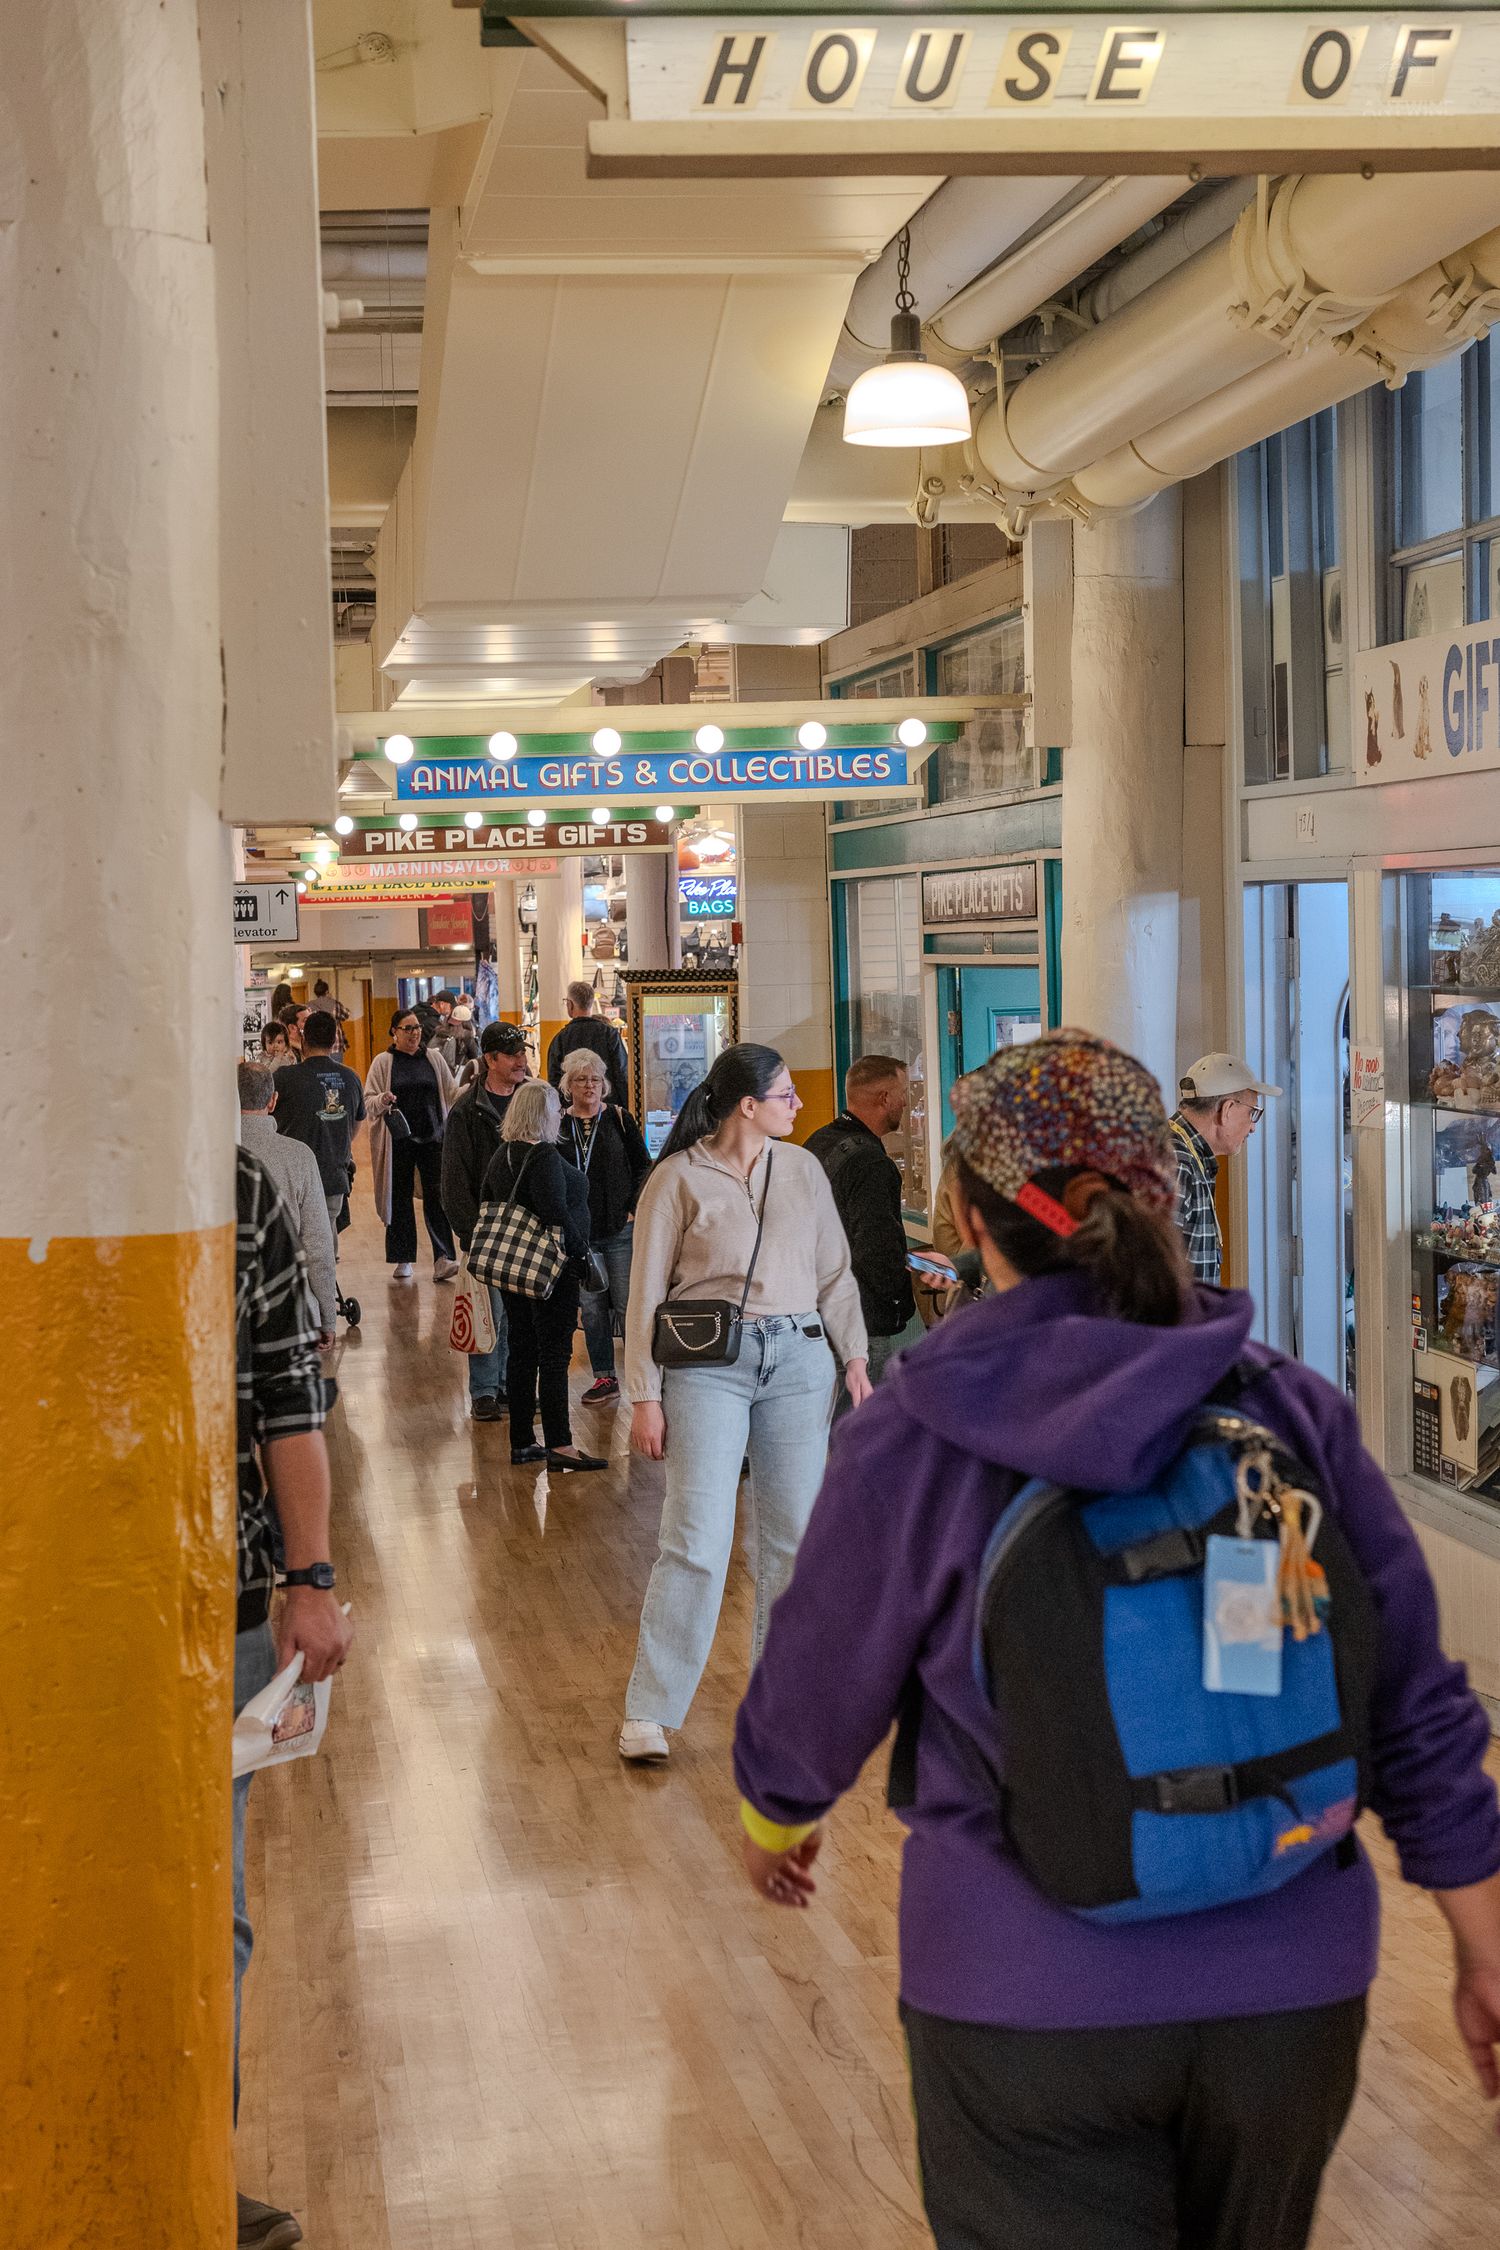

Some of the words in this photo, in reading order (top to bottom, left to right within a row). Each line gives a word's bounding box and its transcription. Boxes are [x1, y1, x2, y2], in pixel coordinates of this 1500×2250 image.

[702, 31, 1159, 105] HOUSE
[1302, 29, 1453, 101] OF
[410, 763, 529, 792] ANIMAL
[538, 759, 625, 788] GIFTS
[633, 759, 659, 786] &
[667, 753, 892, 785] COLLECTIBLES
[365, 830, 436, 852] PIKE
[445, 826, 547, 849] PLACE
[558, 823, 648, 846] GIFTS
[369, 859, 511, 877] MARNINSAYLOR
[688, 899, 735, 915] BAGS
[931, 882, 953, 916] PIKE
[955, 876, 989, 915] PLACE
[990, 872, 1023, 913] GIFTS
